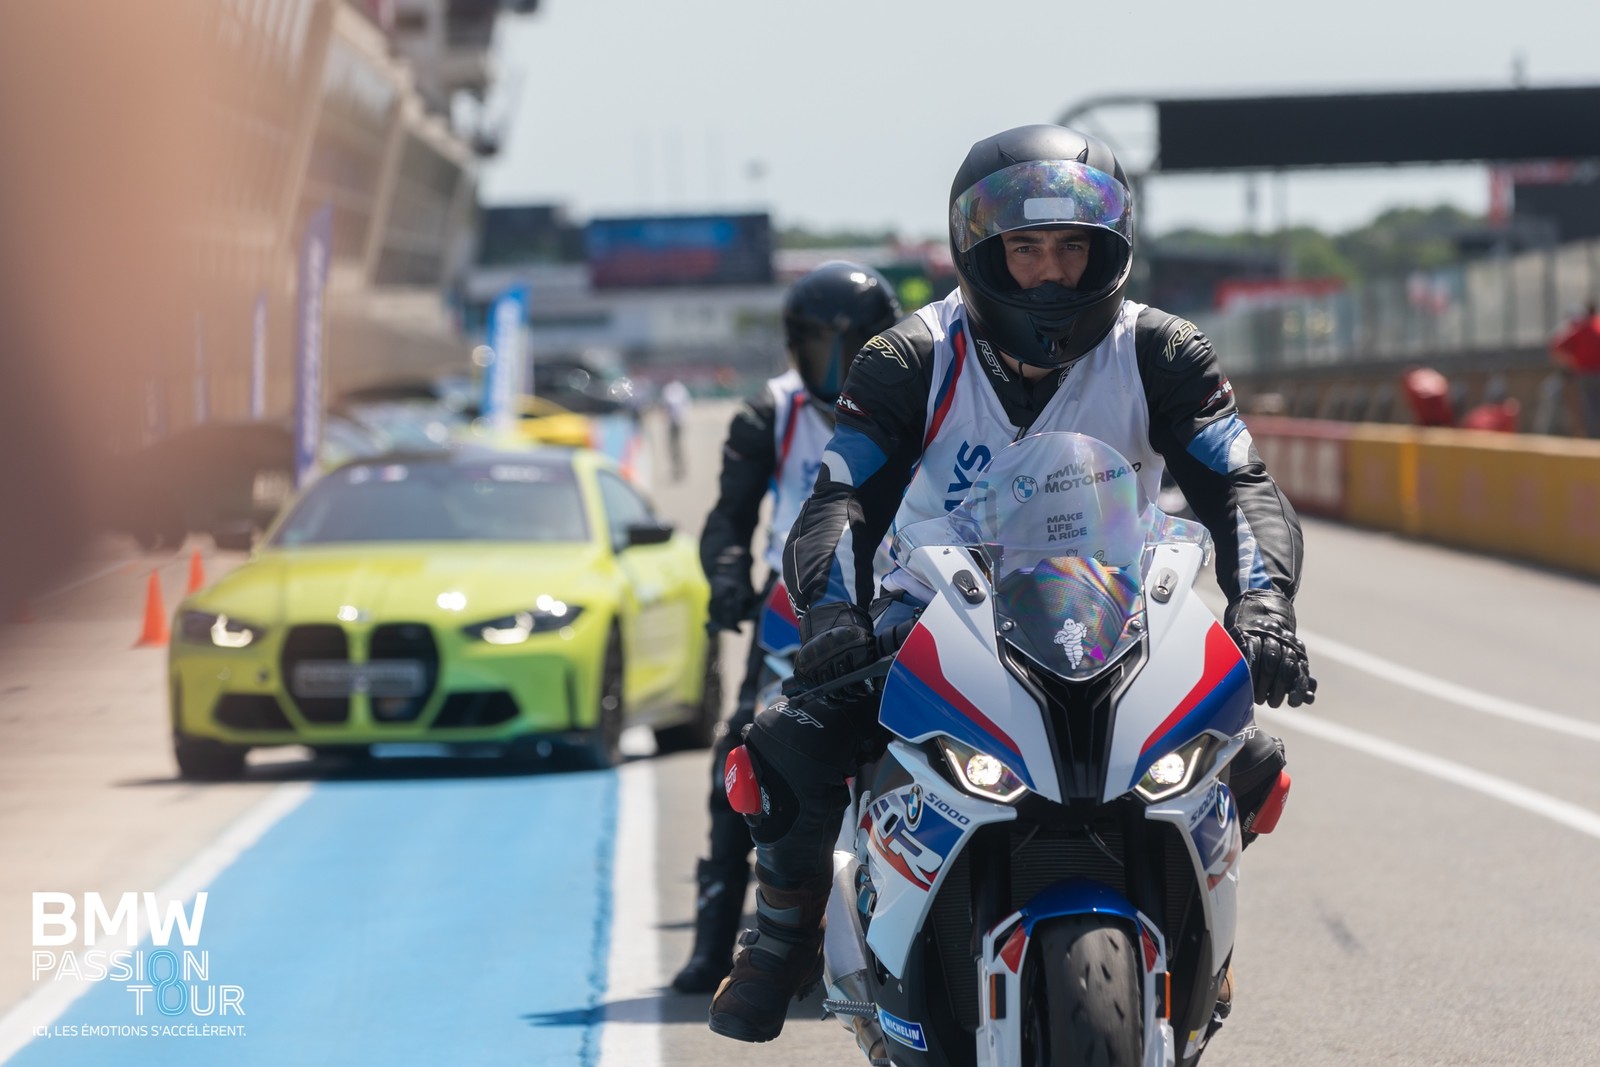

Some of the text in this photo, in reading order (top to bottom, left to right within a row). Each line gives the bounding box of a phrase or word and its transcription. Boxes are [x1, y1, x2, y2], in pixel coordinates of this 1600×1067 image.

[976, 339, 1010, 382] RST
[1046, 512, 1084, 524] MAKE
[1047, 523, 1073, 533] LIFE
[1048, 526, 1088, 542] A RIDE
[924, 792, 971, 826] S1000
[884, 1016, 920, 1041] MICHELIN
